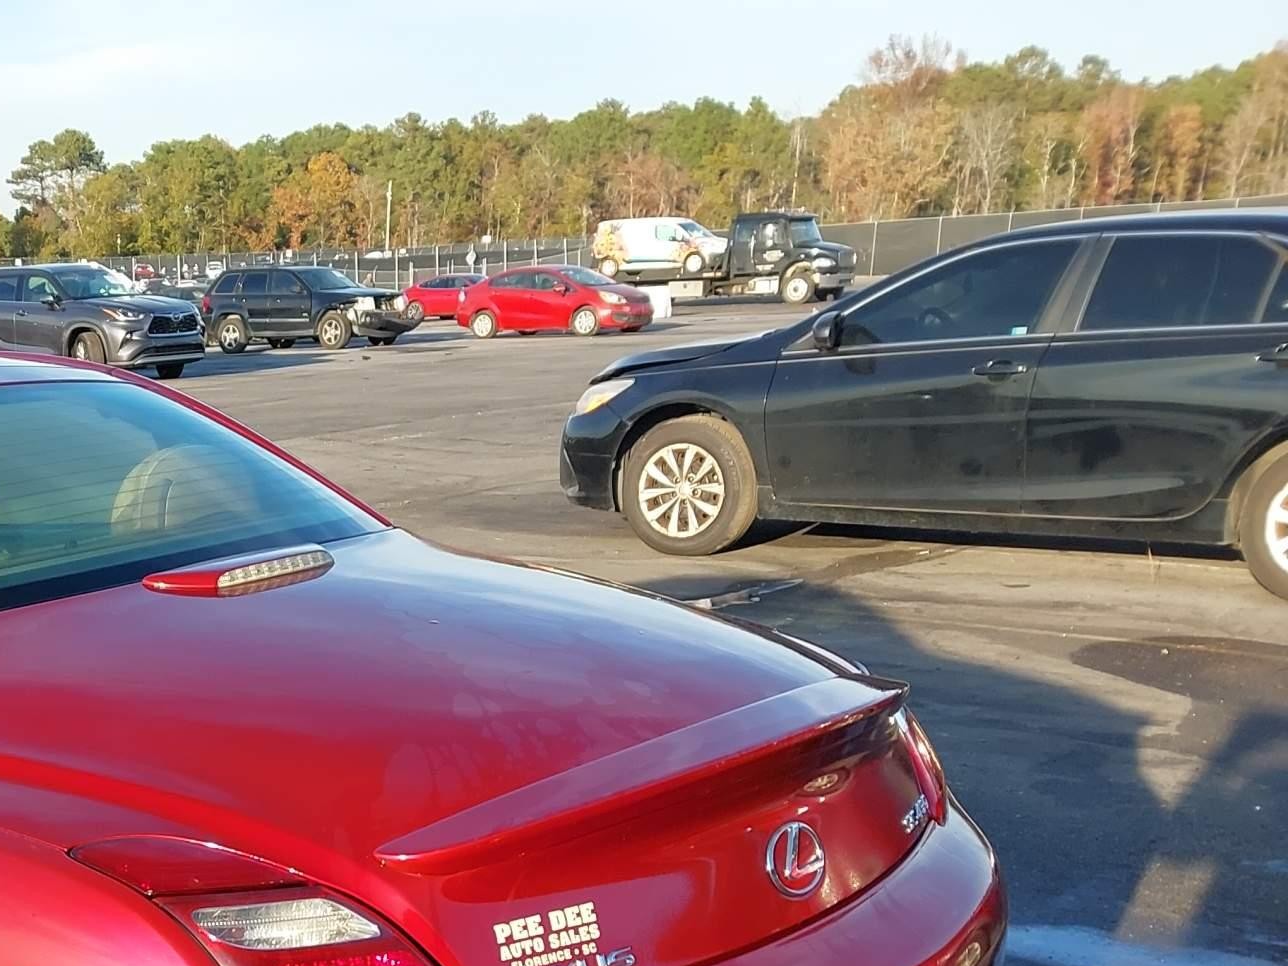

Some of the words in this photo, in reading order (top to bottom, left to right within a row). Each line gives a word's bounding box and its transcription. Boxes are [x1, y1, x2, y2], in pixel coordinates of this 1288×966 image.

[493, 914, 544, 944] PEE
[548, 902, 597, 931] DEE
[500, 938, 545, 961] AUTO
[548, 924, 600, 949] SALES
[581, 942, 597, 957] SC
